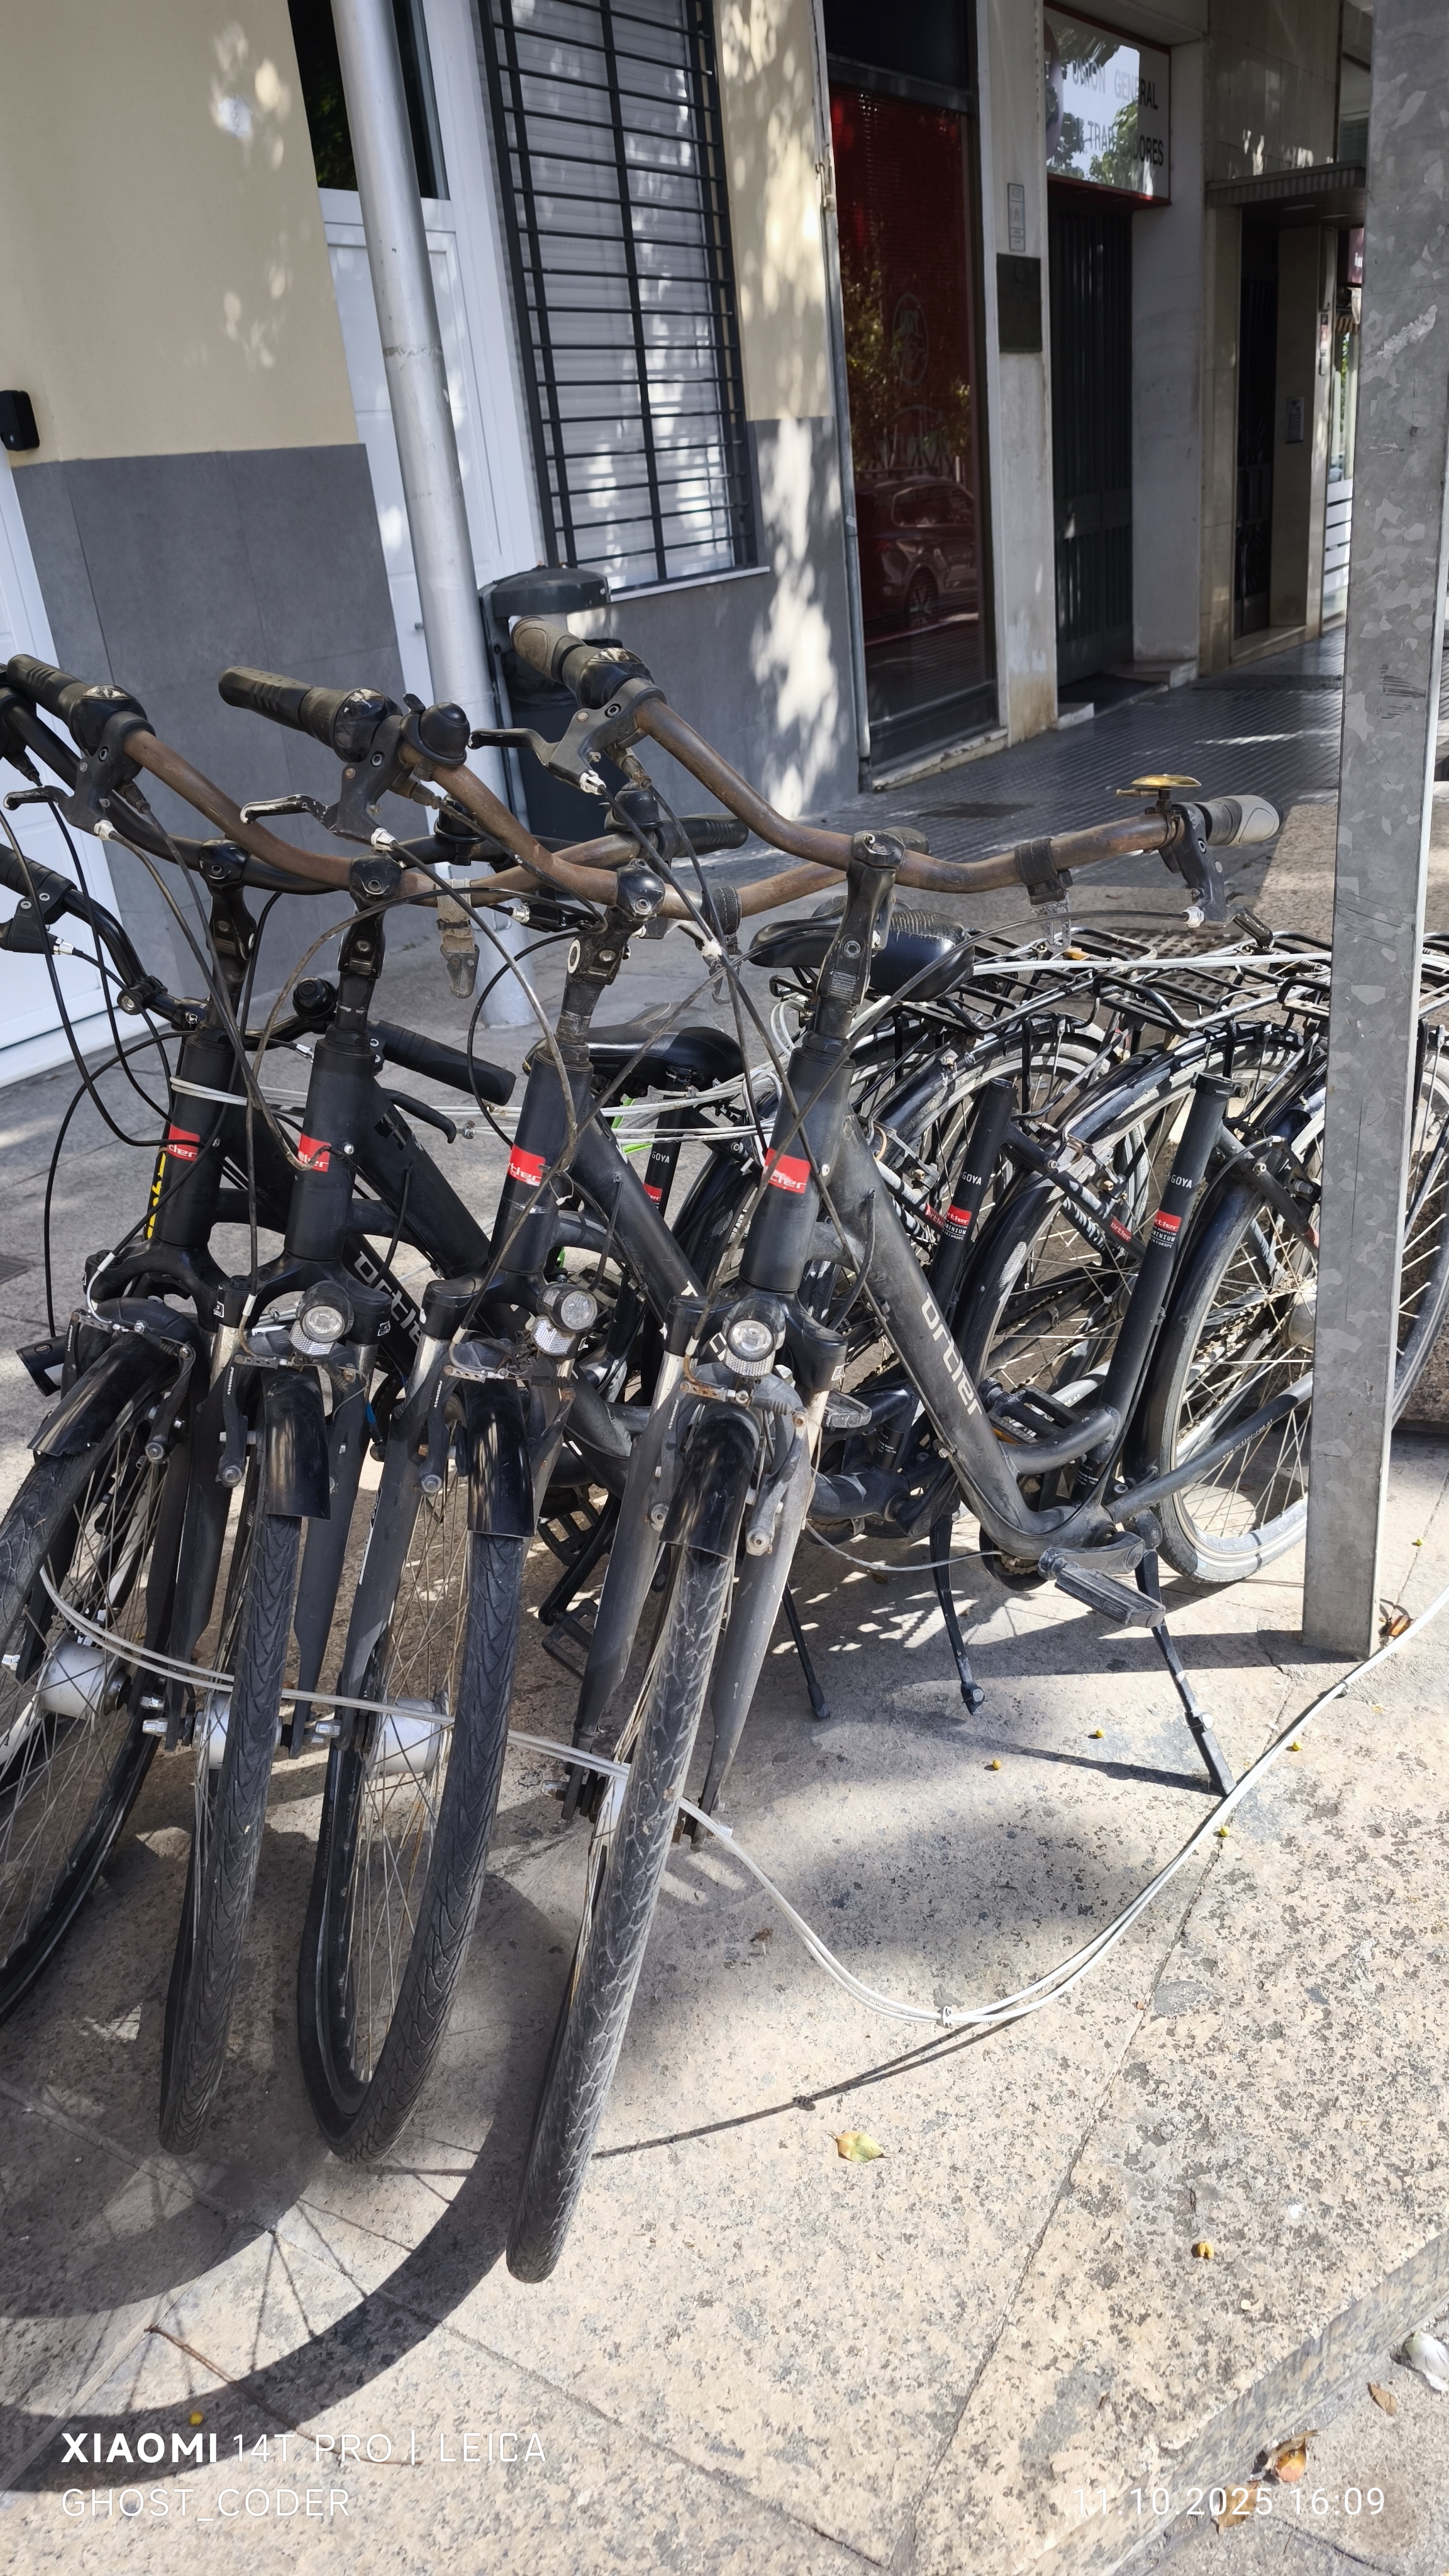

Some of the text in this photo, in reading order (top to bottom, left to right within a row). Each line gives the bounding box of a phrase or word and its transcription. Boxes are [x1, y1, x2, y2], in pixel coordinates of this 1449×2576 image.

[1114, 69, 1159, 110] GENERAL
[652, 1151, 670, 1163] GOYA
[1111, 1222, 1131, 1240] ortler
[921, 1291, 982, 1416] ortler
